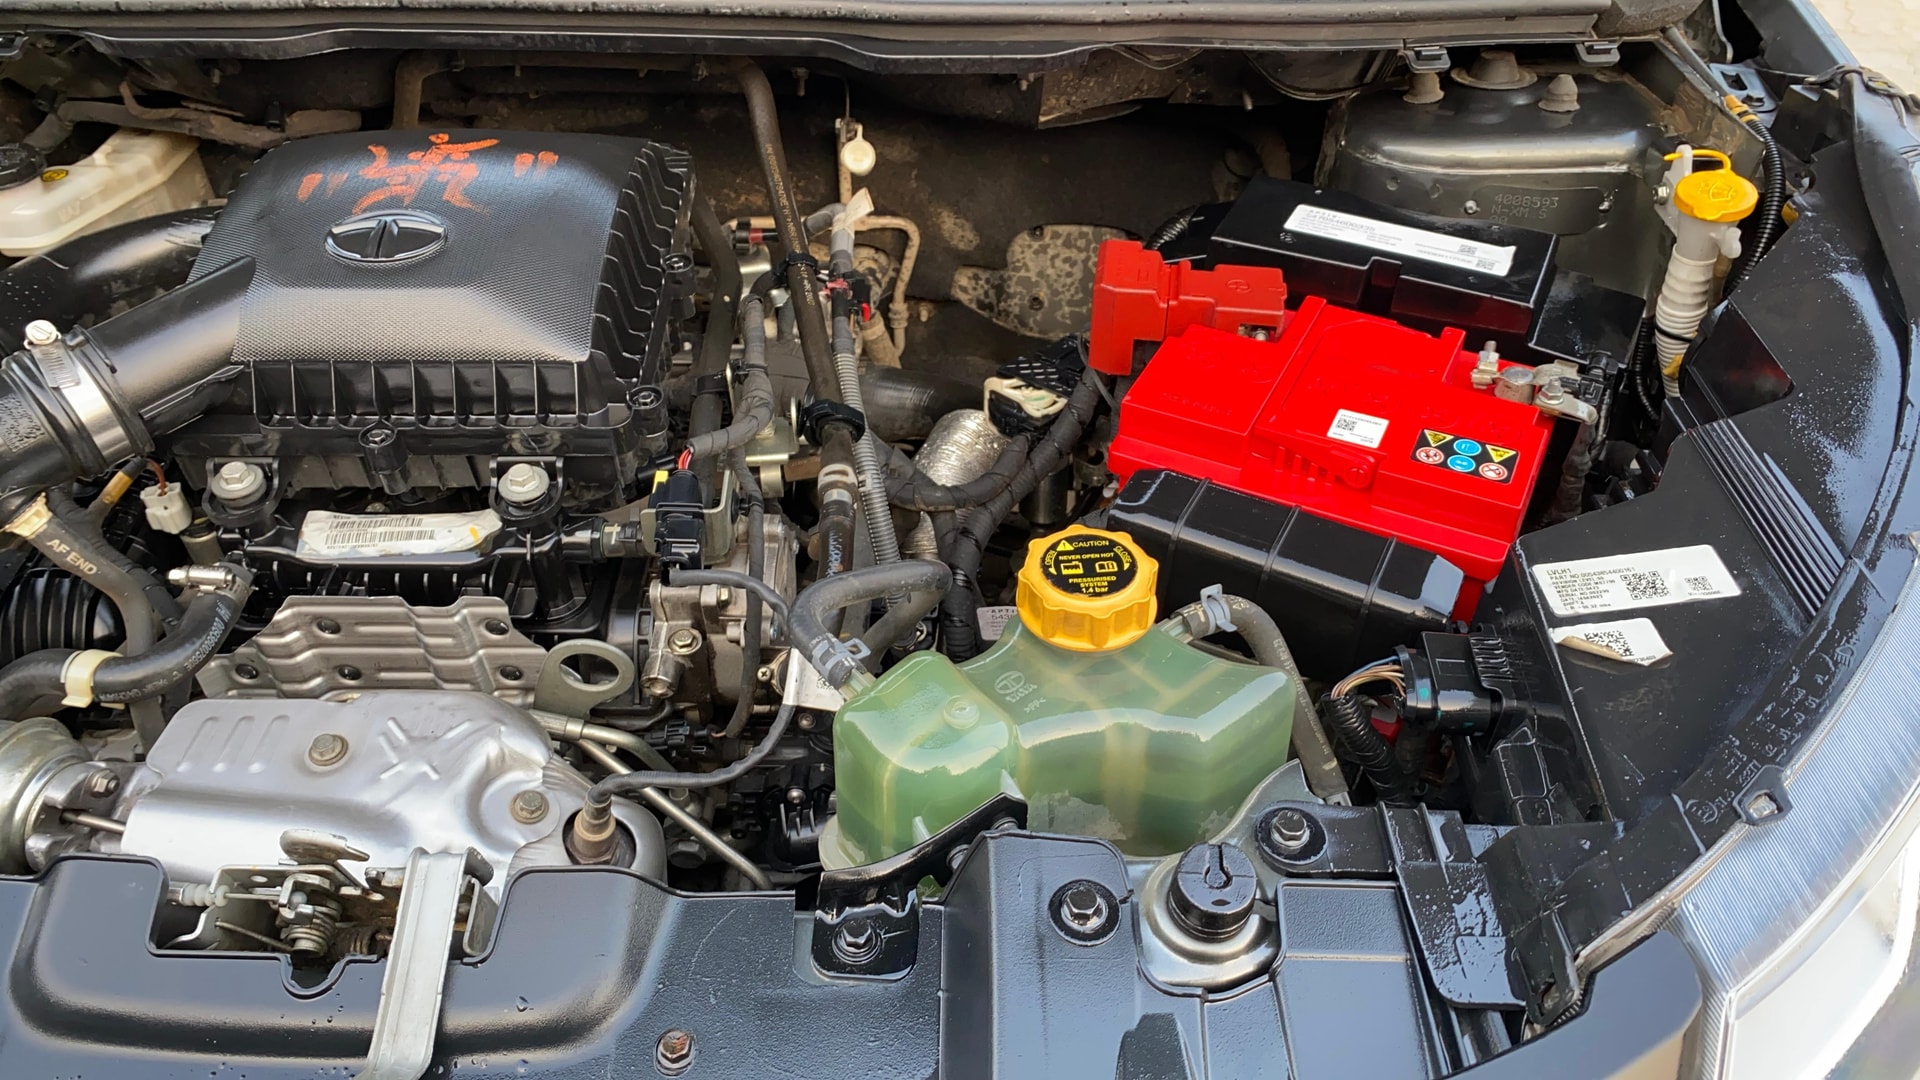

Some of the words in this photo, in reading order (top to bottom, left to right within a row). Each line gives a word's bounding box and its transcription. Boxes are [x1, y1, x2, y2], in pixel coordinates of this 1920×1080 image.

[1072, 540, 1109, 548] CAUTION
[47, 539, 67, 554] AF
[66, 552, 98, 575] END
[1044, 549, 1057, 566] OPEN
[1114, 545, 1132, 563] CLOSE
[1068, 576, 1117, 584] PRESSURISED
